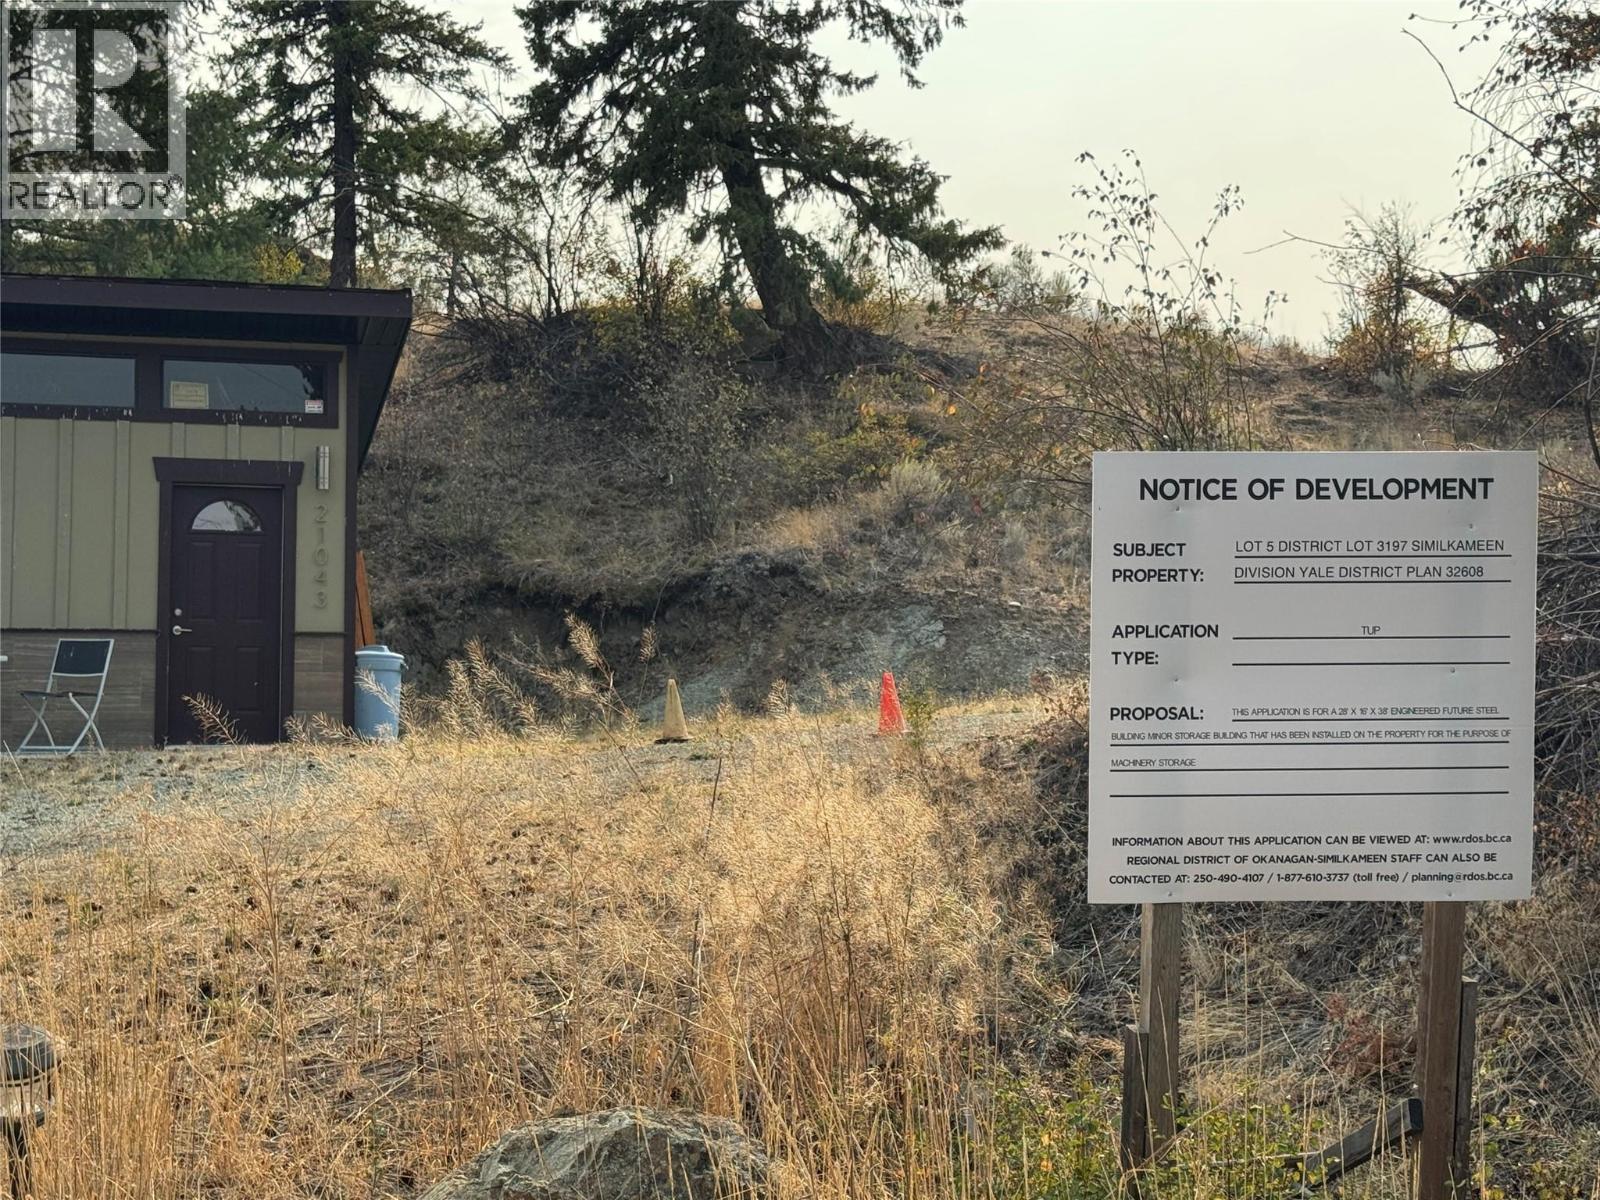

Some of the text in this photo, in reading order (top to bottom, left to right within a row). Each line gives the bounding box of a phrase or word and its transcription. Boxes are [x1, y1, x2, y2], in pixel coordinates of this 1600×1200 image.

[1139, 477, 1495, 502] NOTICE OF DEVELOPMENT
[1112, 542, 1187, 558] SUBJECT
[1235, 539, 1505, 553] LOT 5 DISTRICT LOT 3197 SIMILKAMEEN
[313, 503, 329, 609] 21043
[1111, 567, 1205, 583] PROPERTY:
[1234, 566, 1485, 579] DIVISION YALE DISTRICT PLAN 32608
[1111, 623, 1219, 639] APPLICATION
[1360, 625, 1382, 636] TUP
[1110, 650, 1159, 666] TYPE:
[1109, 705, 1204, 722] PROPOSAL:
[1231, 707, 1250, 717] THIS
[1250, 707, 1301, 717] APPLICATION
[1302, 707, 1311, 716] IS
[1312, 706, 1330, 716] FOR
[1330, 707, 1338, 716] A
[1350, 707, 1357, 716] X
[1369, 707, 1377, 716] X
[1390, 706, 1441, 716] ENGINEERED
[1442, 706, 1474, 715] FUTURE
[1475, 705, 1500, 715] STEEL
[1110, 729, 1512, 741] BUILDING MINOR STORAGE BUILDING THAT HAS BEEN INSTALLED ON THE PROPERTY FOR THE PURPOSE OF
[1110, 758, 1197, 768] MACHINERY STORAGE
[1111, 833, 1513, 848] INFORMATION ABOUT THIS APPLICATION CAN BE VIEWED AT: www.rdos.bc.ca
[1126, 852, 1498, 866] REGIONAL DISTRICT OF OKANAGAN-SIMILKAMEEN STAFF CAN ALSO BE
[1108, 874, 1172, 885] CONTACTED
[1174, 873, 1191, 884] AT:
[1192, 873, 1265, 884] 250-490-4107
[1276, 872, 1350, 884] 1-877-610-3737
[1352, 872, 1373, 884] (toll
[1375, 872, 1400, 884] free)
[1411, 871, 1514, 884] planning@rdos.bc.ca
